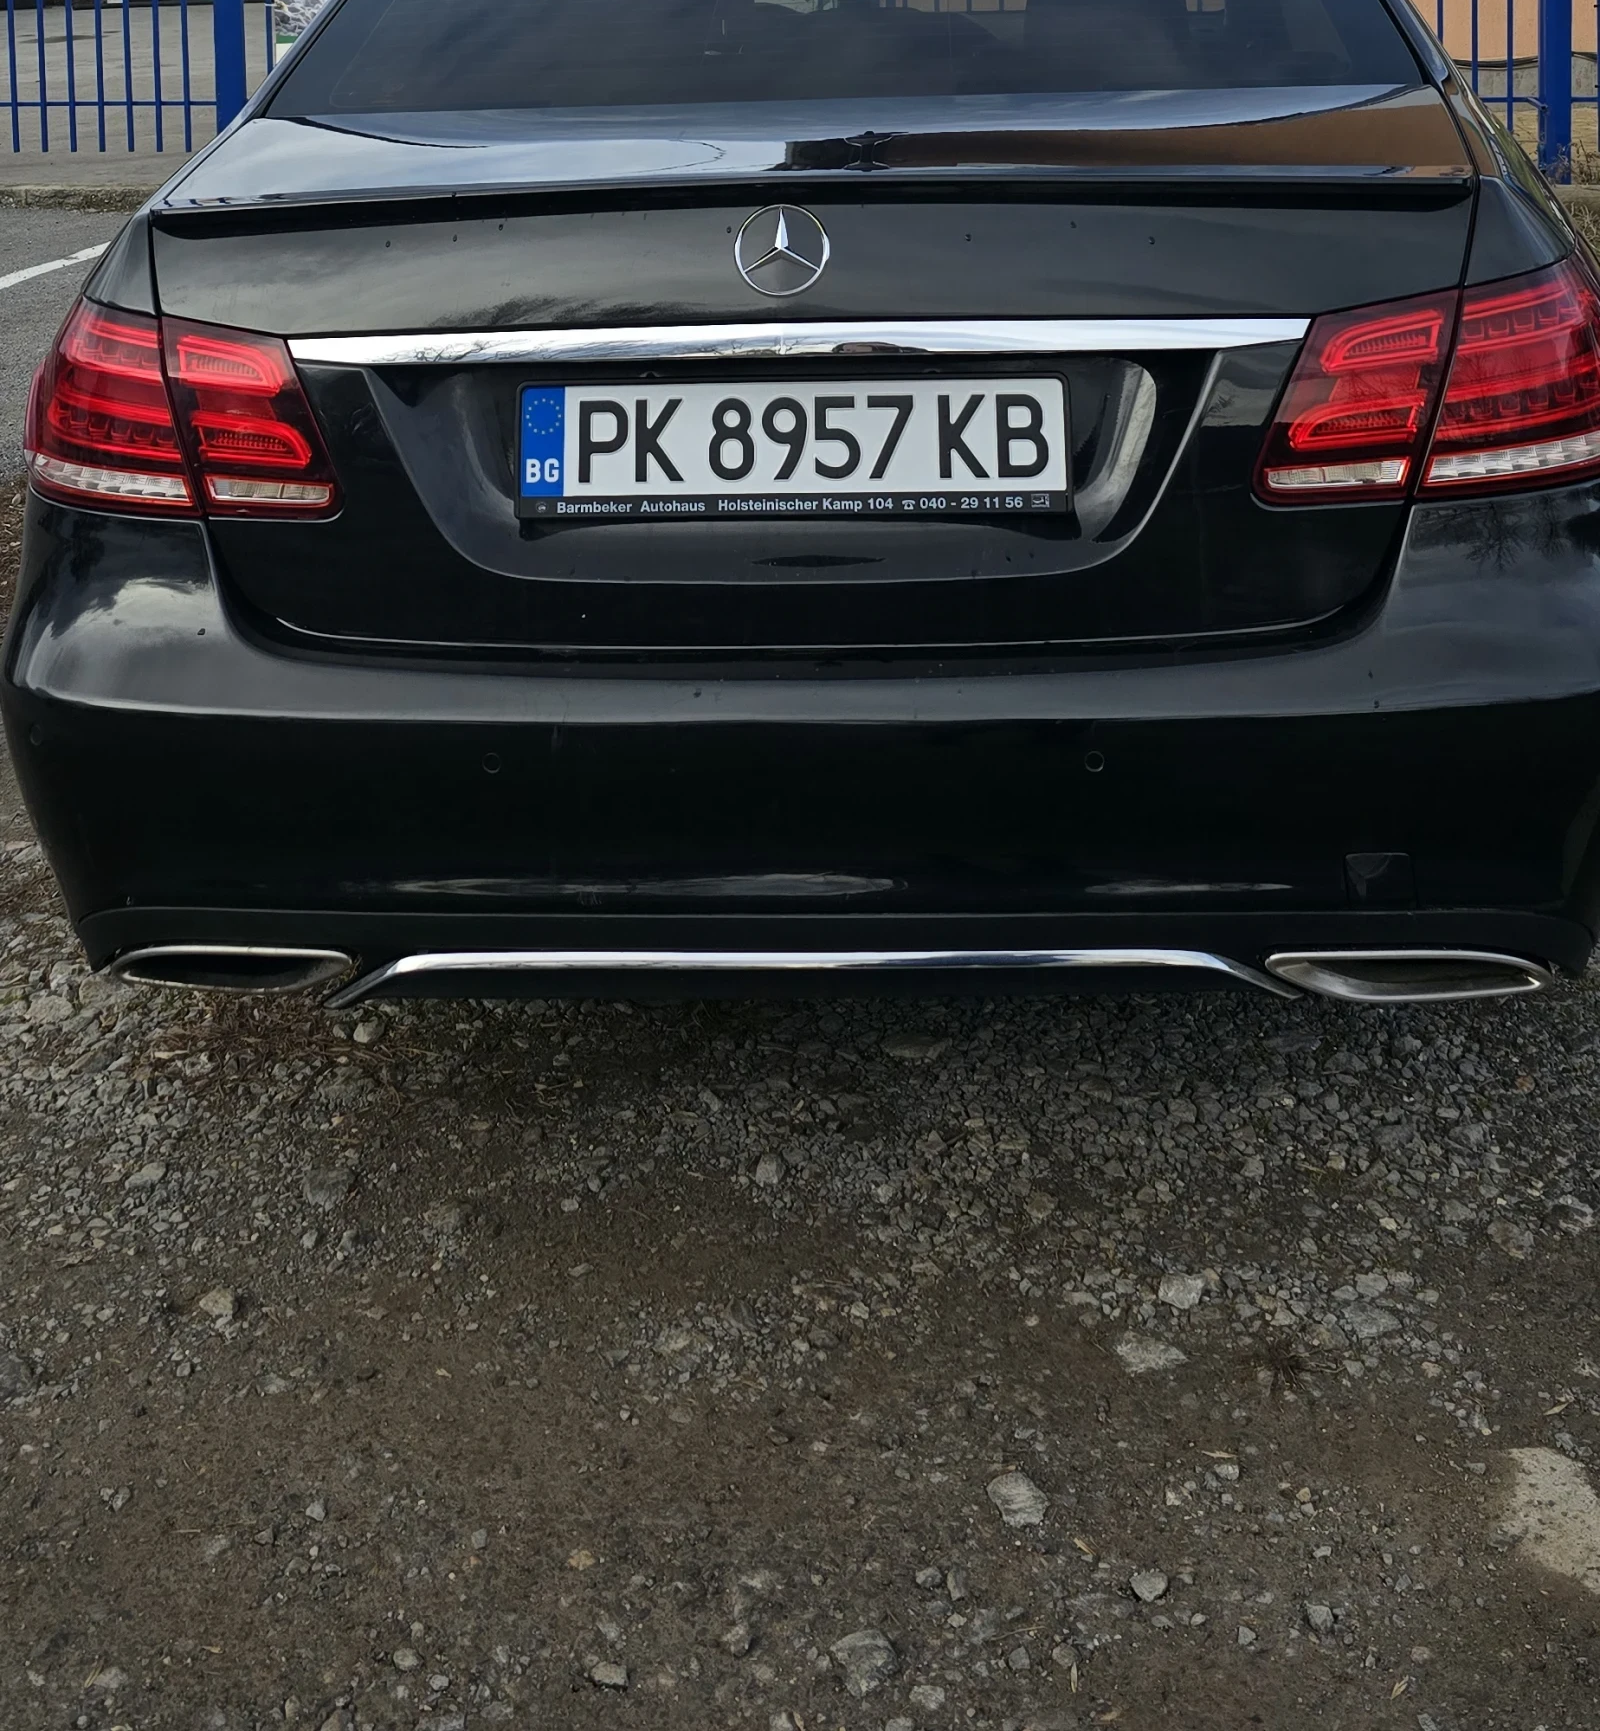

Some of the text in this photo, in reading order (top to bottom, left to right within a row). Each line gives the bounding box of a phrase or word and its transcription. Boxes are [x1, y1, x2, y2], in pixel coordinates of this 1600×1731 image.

[578, 394, 1049, 484] PK 8957 KB
[526, 458, 559, 483] BG
[556, 500, 633, 514] Barmbeker
[640, 500, 706, 513] Autohaus
[718, 498, 819, 513] Holsteinischer
[822, 498, 863, 513] Kamp
[867, 497, 894, 510] 104
[919, 496, 946, 510] 040
[960, 496, 979, 510] 29
[983, 496, 999, 509] 11
[1005, 495, 1024, 509] 56
